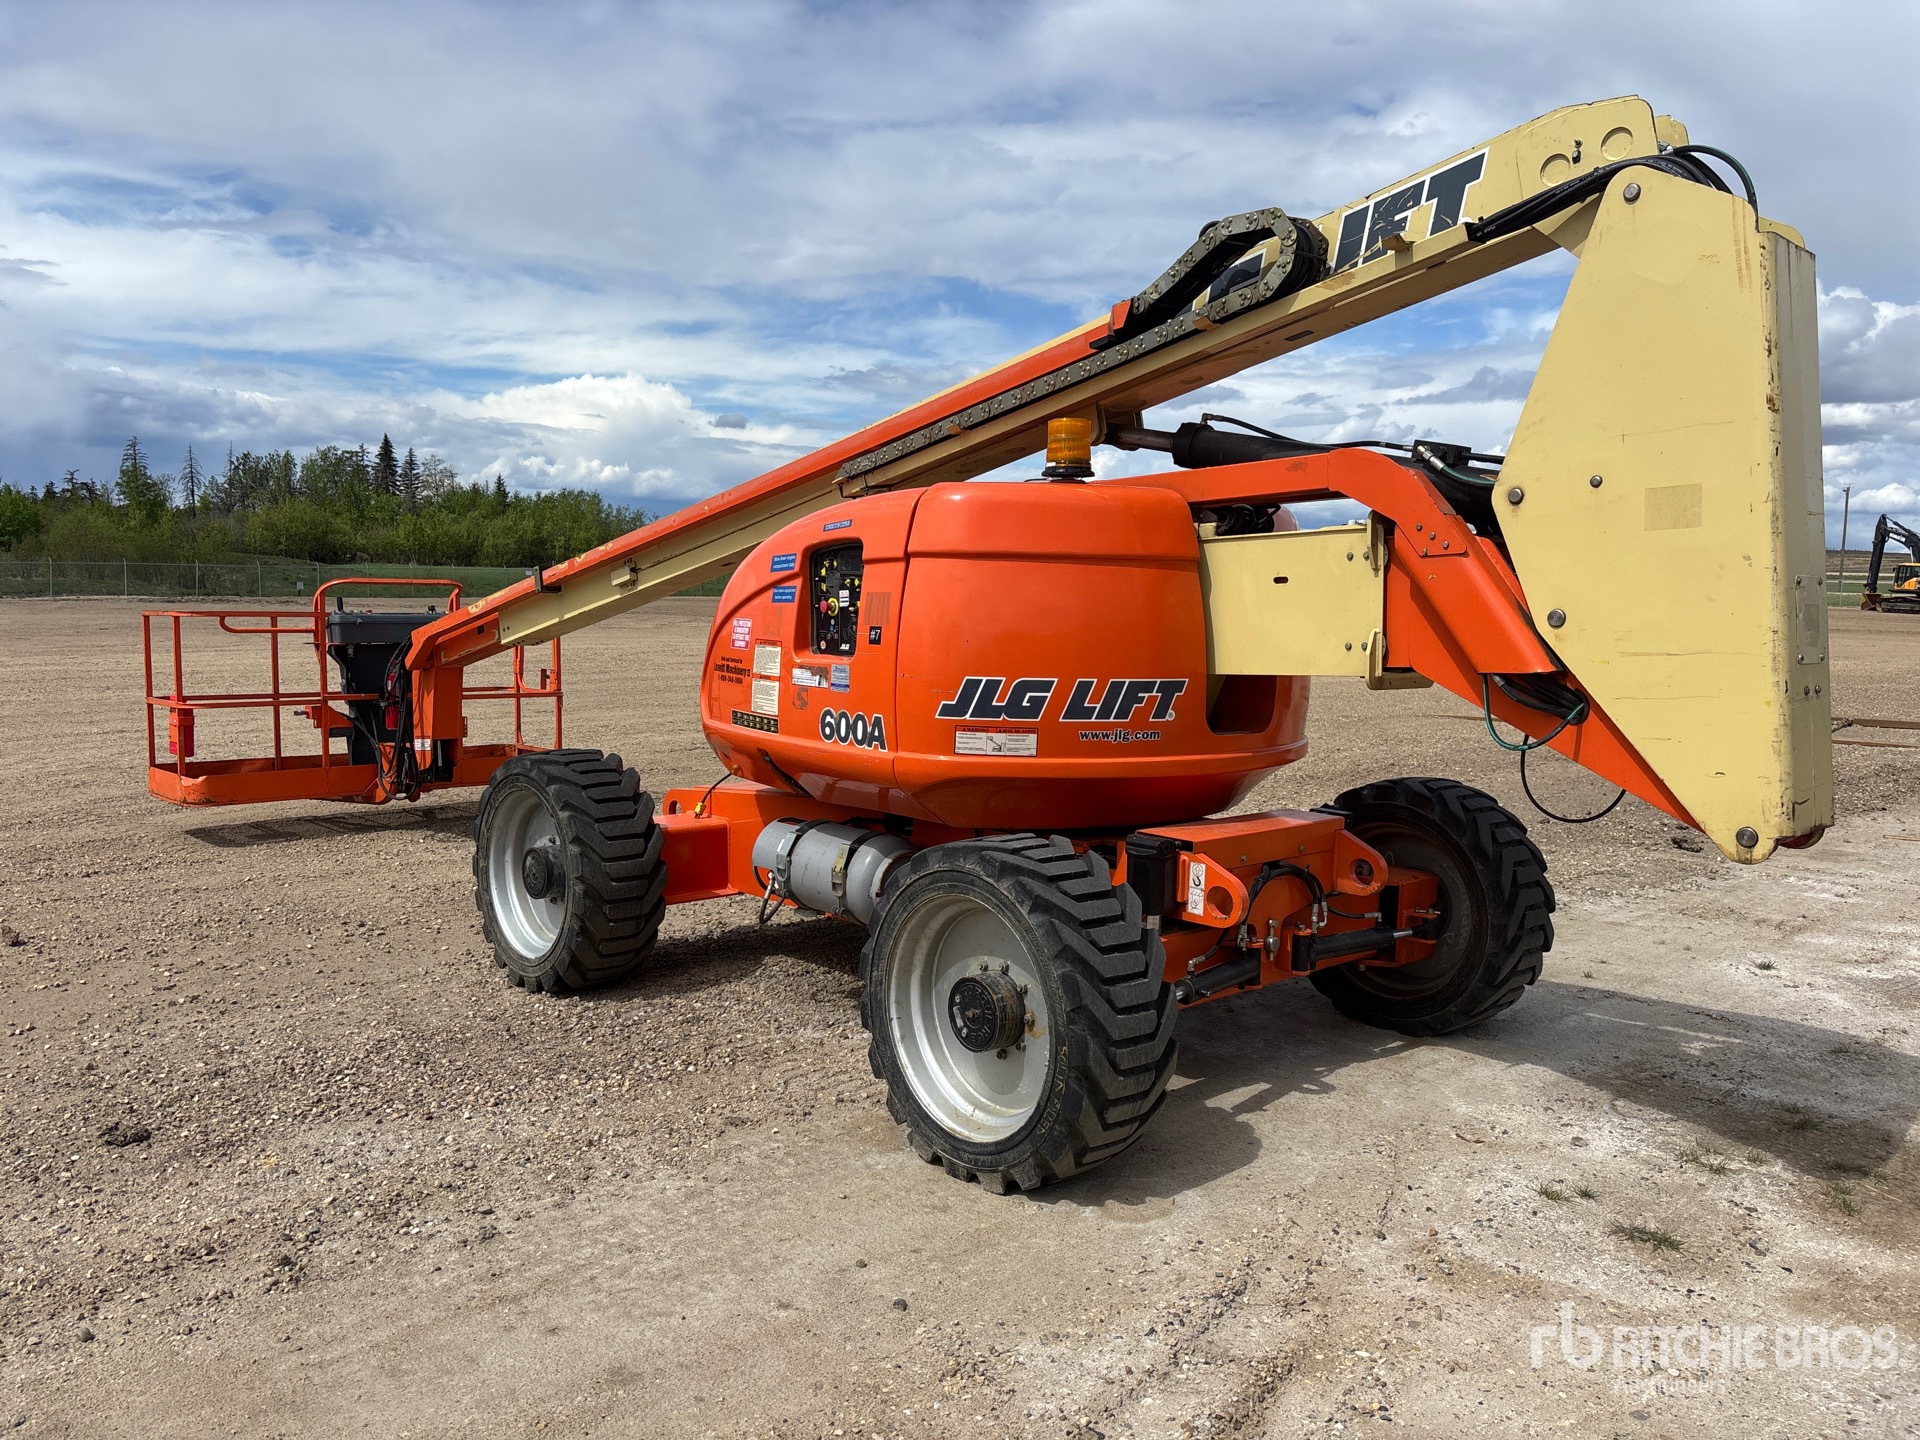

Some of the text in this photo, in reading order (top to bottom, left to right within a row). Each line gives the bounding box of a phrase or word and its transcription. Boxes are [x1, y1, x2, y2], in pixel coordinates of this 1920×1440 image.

[1328, 146, 1490, 275] IFT
[870, 629, 880, 641] #7
[935, 676, 1189, 722] JLG LIFT
[819, 707, 888, 752] 600A
[1079, 728, 1160, 743] www.jlg.com
